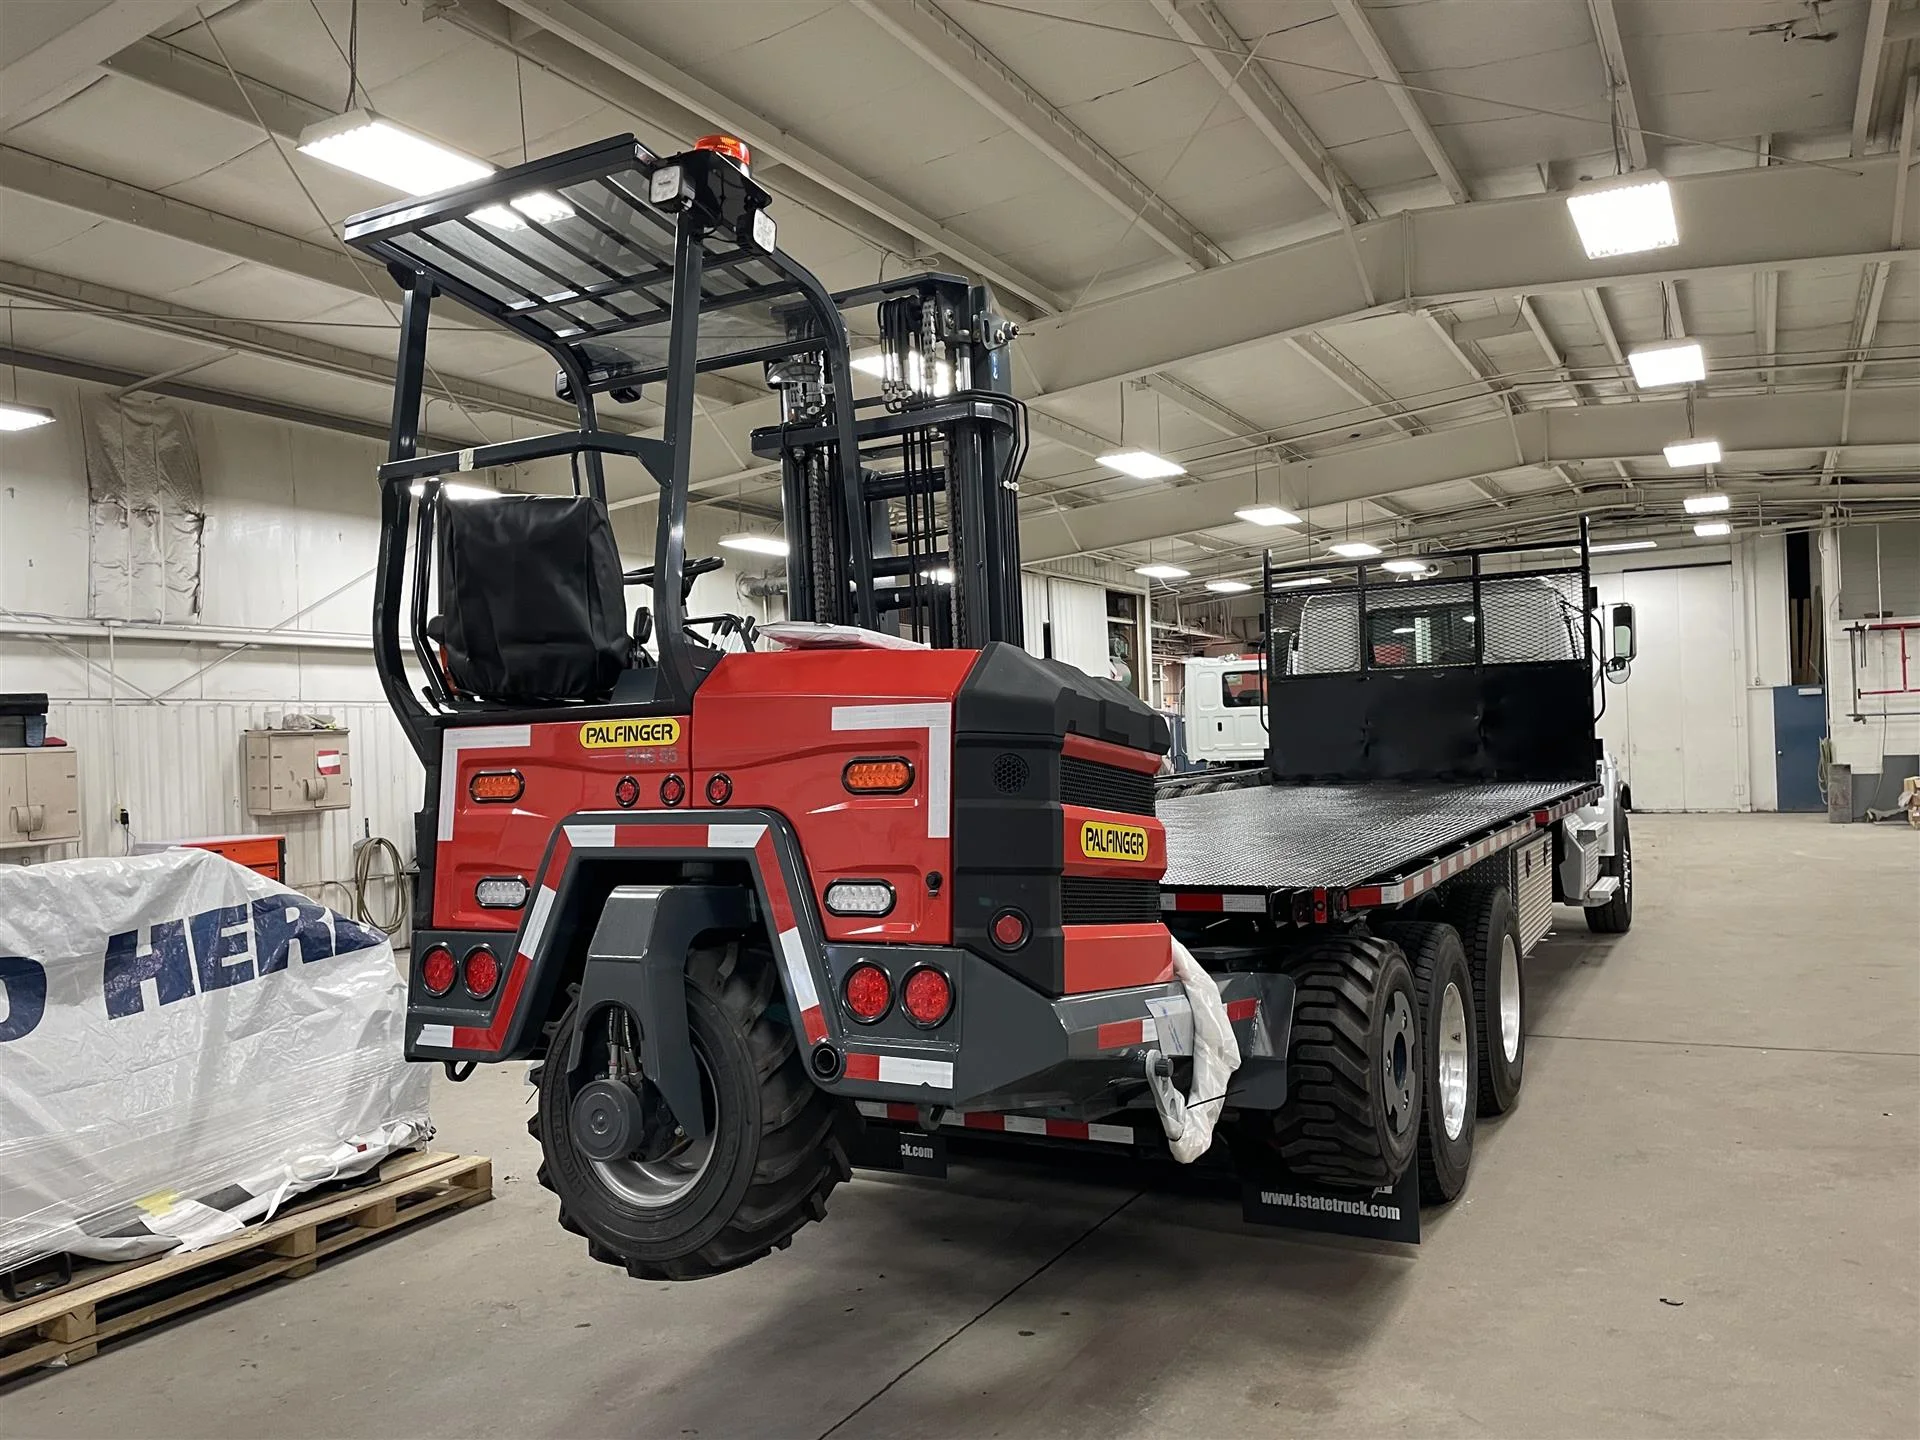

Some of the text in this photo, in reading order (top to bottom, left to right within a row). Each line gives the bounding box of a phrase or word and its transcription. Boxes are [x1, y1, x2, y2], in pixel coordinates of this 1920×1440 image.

[586, 724, 673, 744] PALFINGER
[1085, 828, 1144, 855] PALFINGER
[900, 1144, 933, 1159] ck.com
[1261, 1191, 1400, 1220] www.istatetruck.com
